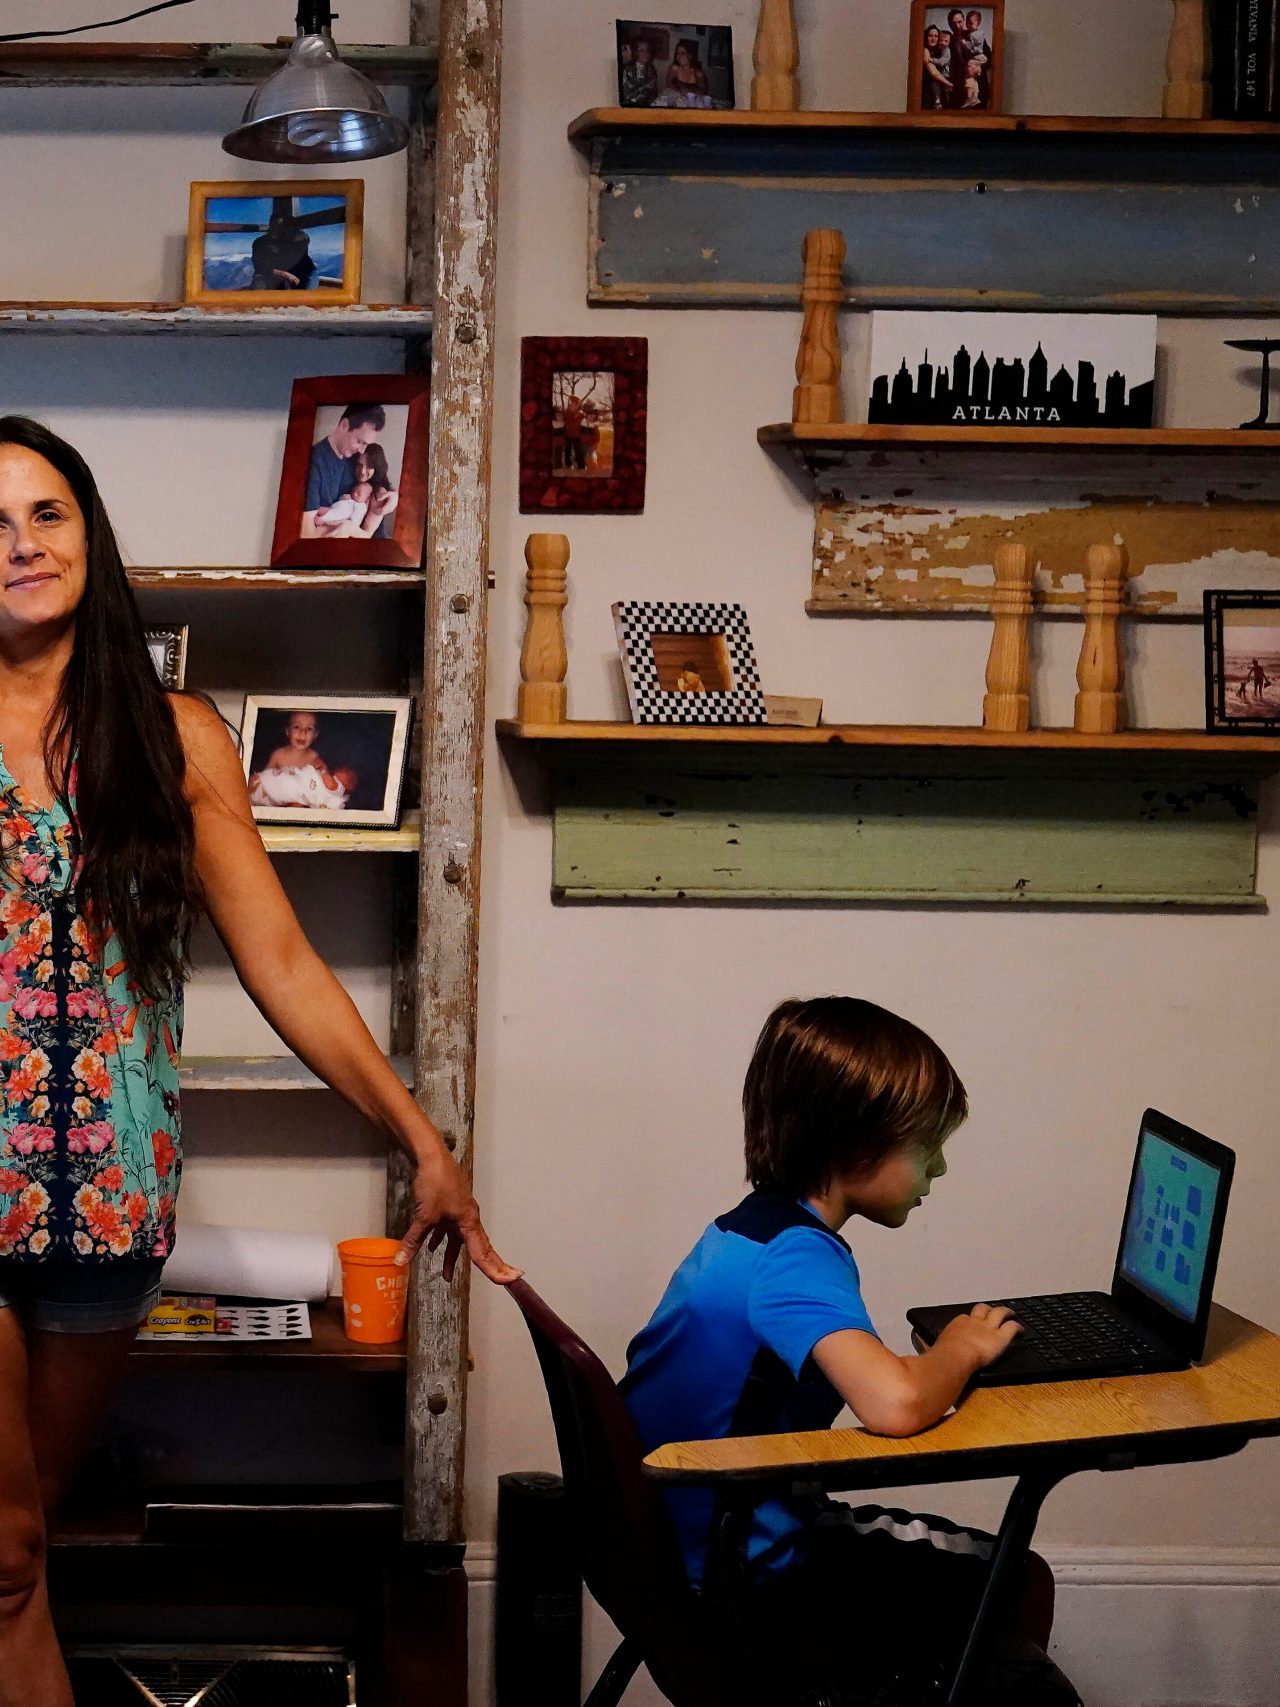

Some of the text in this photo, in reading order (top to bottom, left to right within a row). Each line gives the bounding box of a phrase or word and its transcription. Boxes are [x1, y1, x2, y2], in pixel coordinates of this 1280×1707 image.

[1247, 53, 1257, 75] VOL
[1246, 80, 1256, 97] 147
[952, 406, 1061, 421] ATLANTA
[150, 1316, 180, 1326] Crayons
